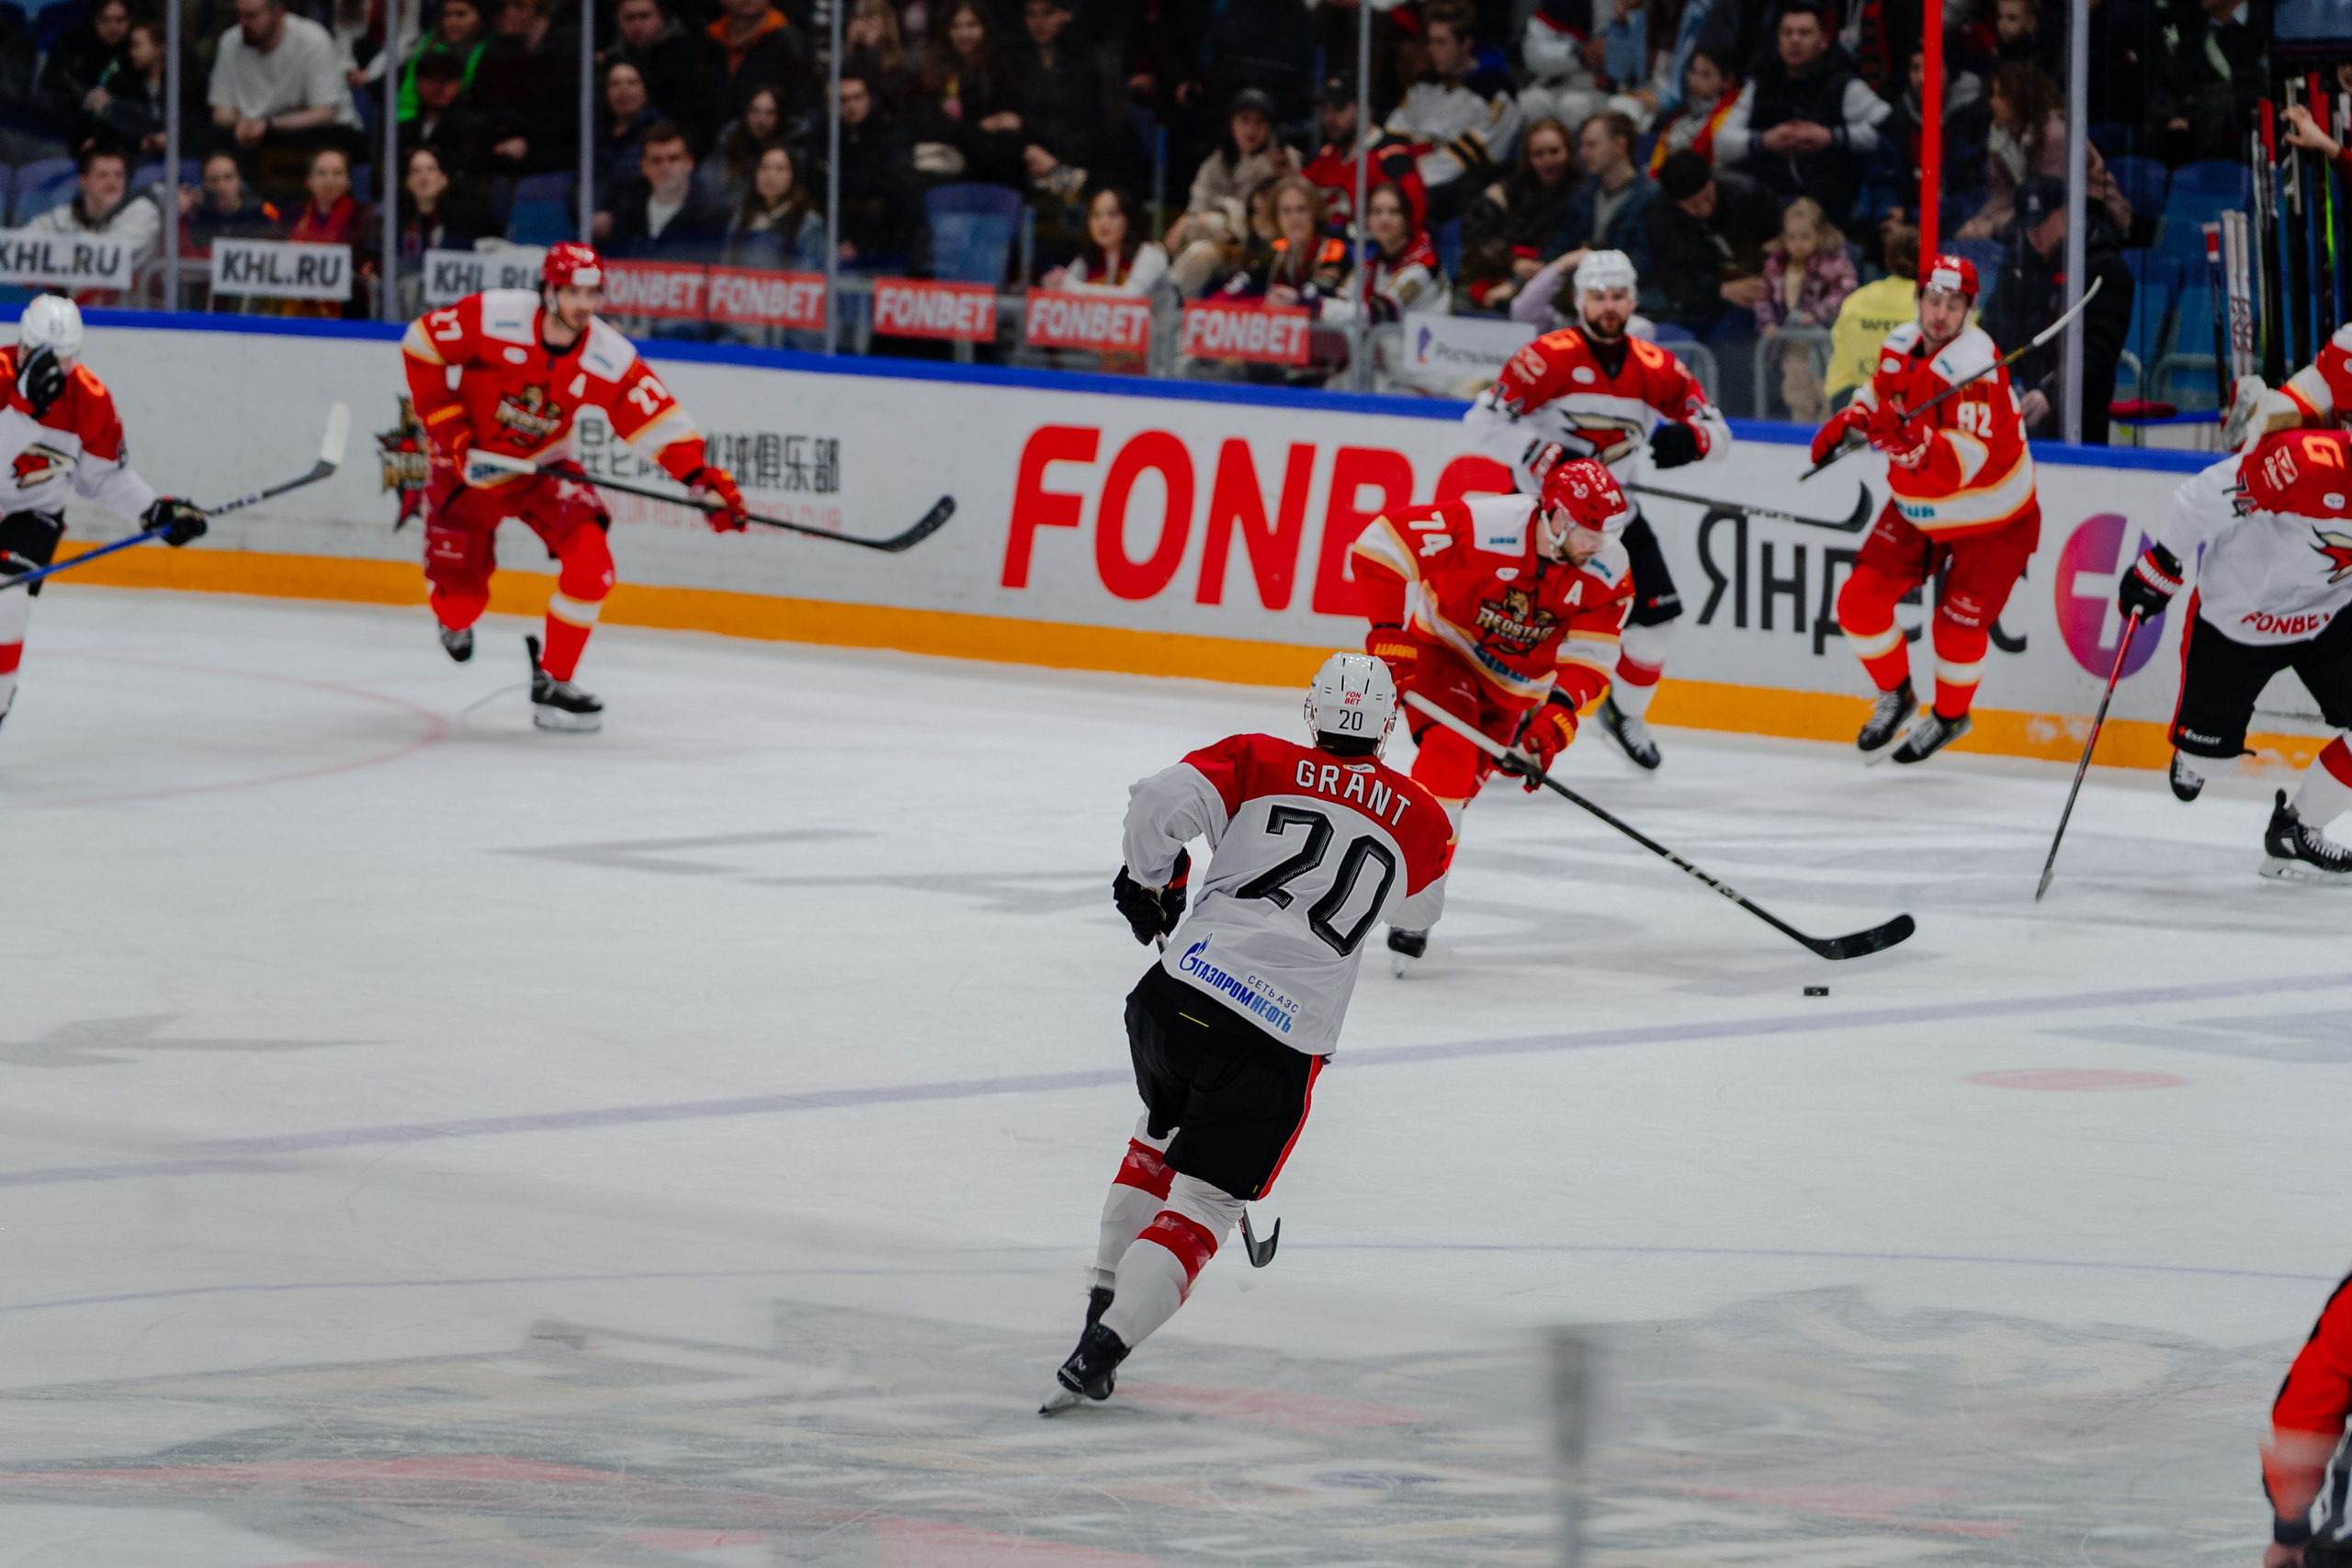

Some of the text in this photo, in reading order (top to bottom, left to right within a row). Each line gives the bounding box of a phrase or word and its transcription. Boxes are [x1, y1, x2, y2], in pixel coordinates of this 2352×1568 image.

[222, 249, 343, 288] KHL.RU
[603, 268, 704, 310] ONBET
[708, 275, 822, 320] FONBET
[876, 287, 994, 333] FONBET
[1029, 297, 1149, 344] FONBET
[1185, 309, 1309, 355] FONBET
[628, 375, 669, 415] 27
[1957, 401, 1993, 438] 92
[1408, 510, 1453, 558] 74
[1563, 580, 1584, 607] A
[1344, 697, 1362, 705] BET
[1345, 691, 1363, 699] FON
[1339, 709, 1363, 731] 20
[1295, 759, 1412, 827] GRANT
[1235, 804, 1396, 957] 20
[1192, 960, 1293, 1034] ГАЗПРОМНЕФТЬ
[1247, 975, 1299, 1013] СЕТЬ АЗС
